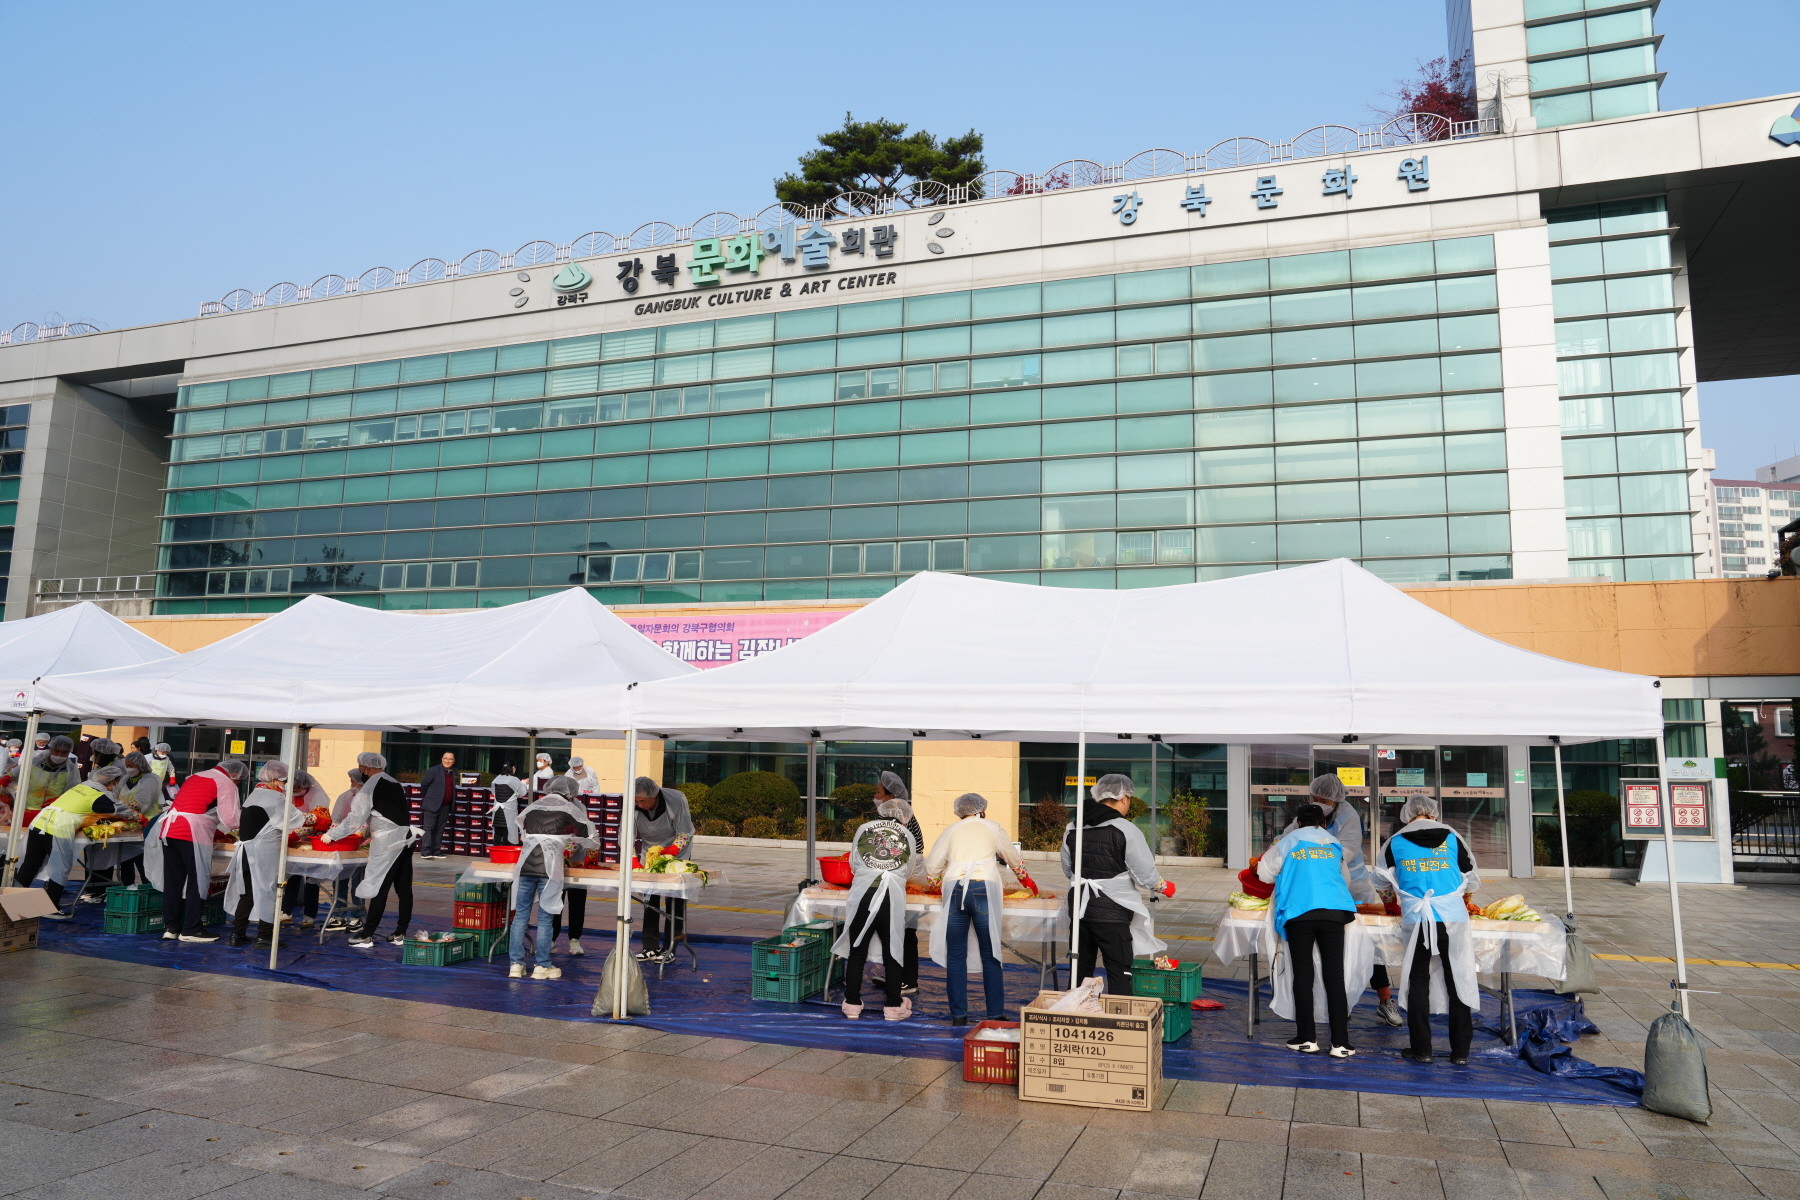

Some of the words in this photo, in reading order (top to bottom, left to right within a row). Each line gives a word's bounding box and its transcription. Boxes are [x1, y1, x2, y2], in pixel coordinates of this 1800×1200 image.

[556, 293, 588, 307] 강북구
[634, 297, 700, 316] GANGBUK
[707, 286, 772, 307] CULTURE
[779, 282, 792, 298] &
[799, 278, 830, 296] ART
[837, 271, 897, 291] CENTER
[682, 622, 735, 634] 강북구협의회
[1054, 1027, 1114, 1042] 1041426
[1053, 1043, 1106, 1056] 김치락(12L)
[1053, 1058, 1065, 1066] 8입
